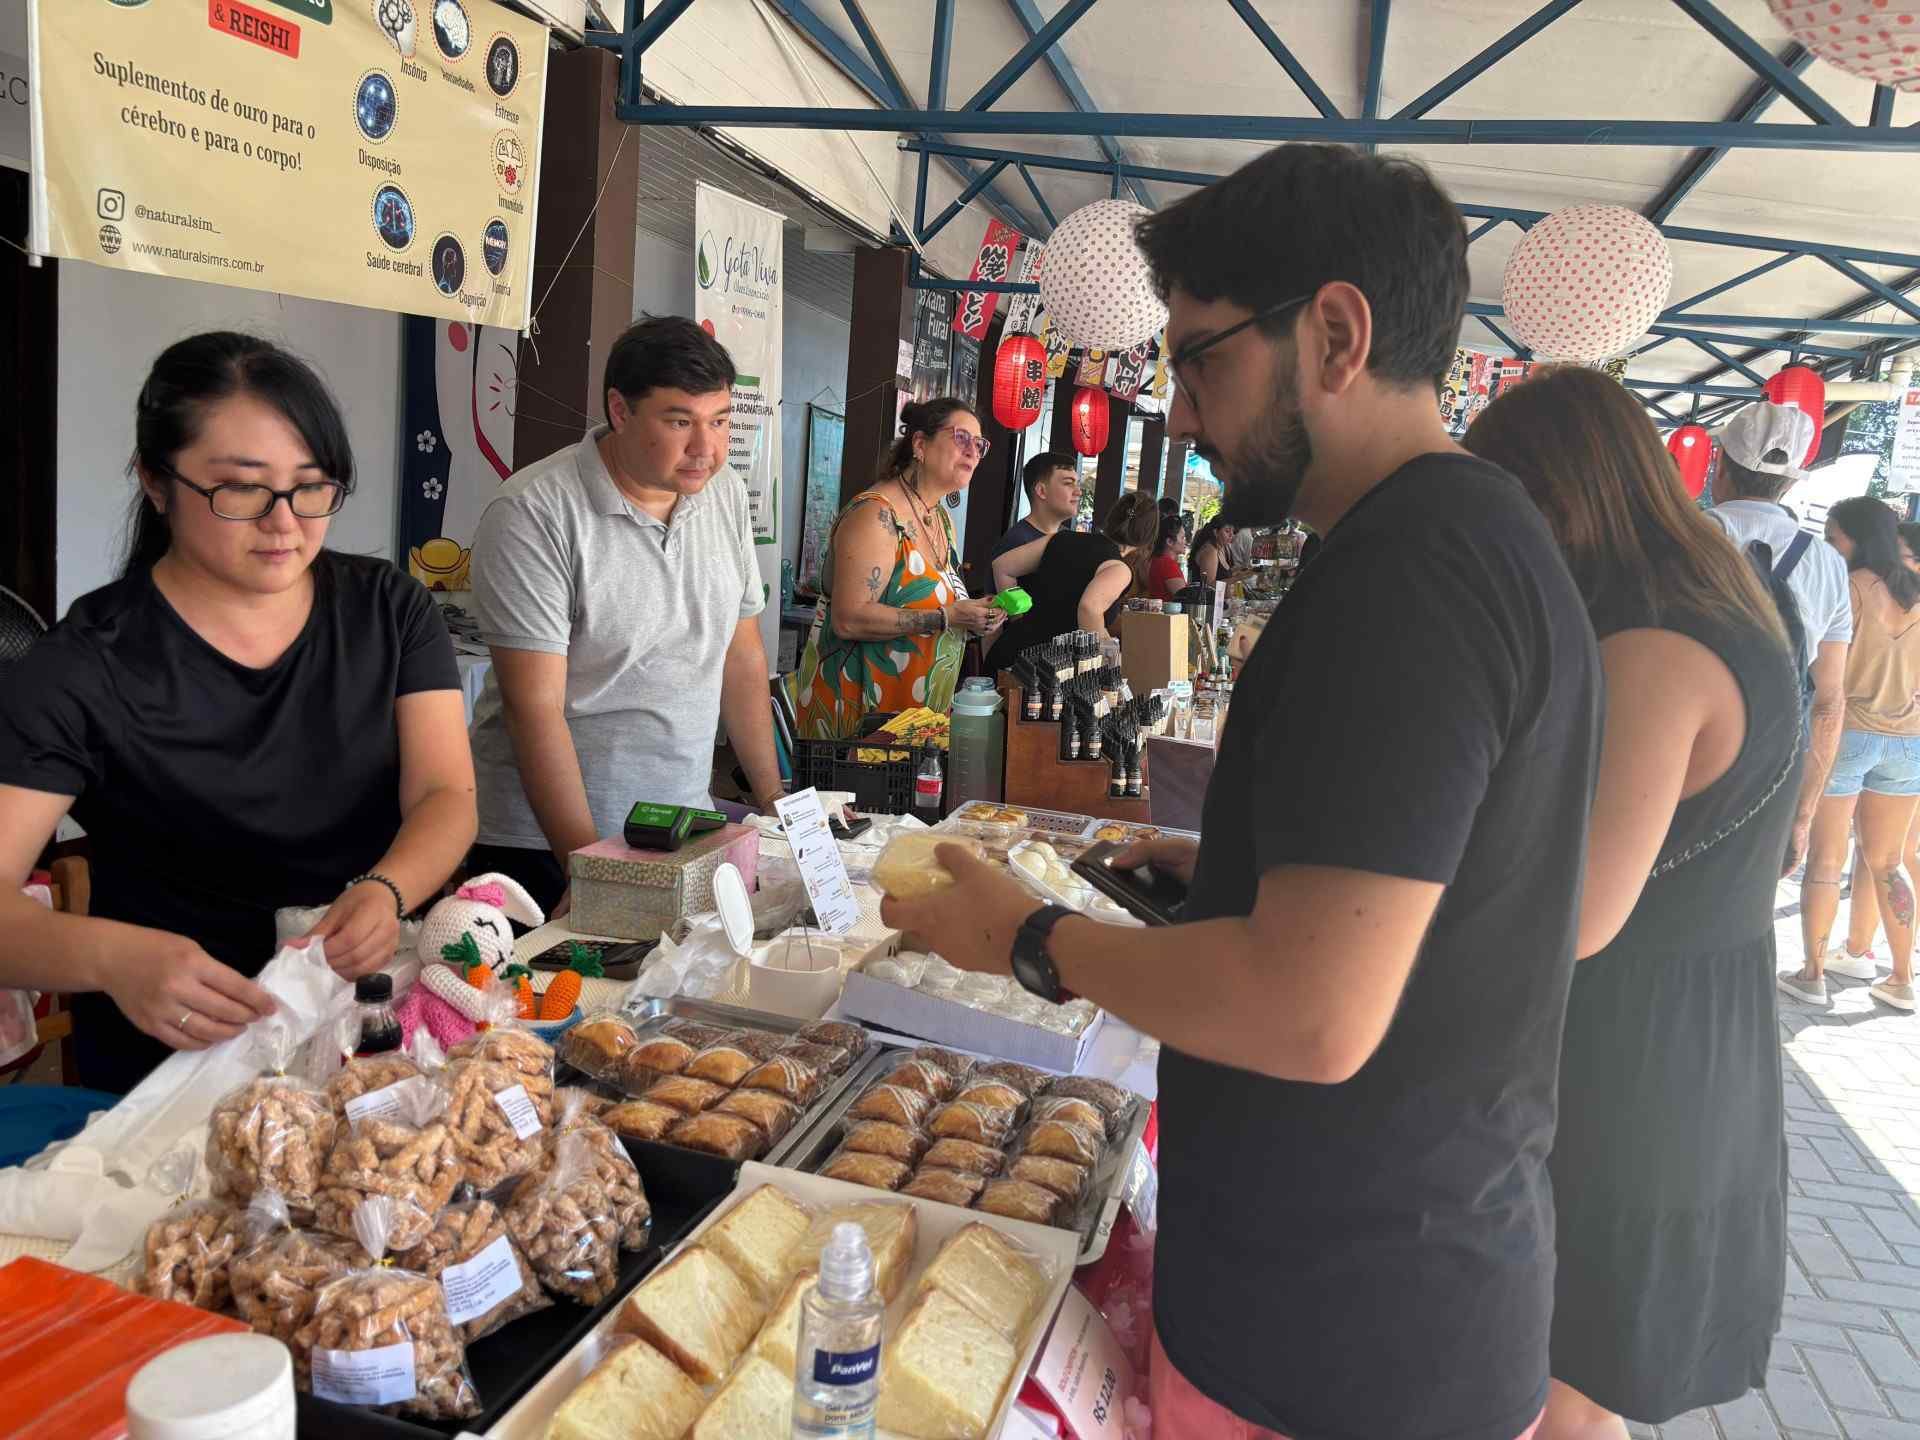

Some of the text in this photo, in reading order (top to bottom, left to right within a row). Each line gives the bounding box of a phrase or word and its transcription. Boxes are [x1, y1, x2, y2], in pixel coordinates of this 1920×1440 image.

[214, 4, 291, 51] & REISHI
[400, 59, 428, 83] Insônia
[93, 51, 315, 140] Suplementos de ouro para o
[121, 104, 302, 172] cérebro e para o corpo!
[359, 149, 402, 177] Disposição
[131, 241, 266, 274] www.naturalsimrs.com.br
[366, 251, 423, 277] Saúde cerebral
[724, 236, 751, 292] Gota
